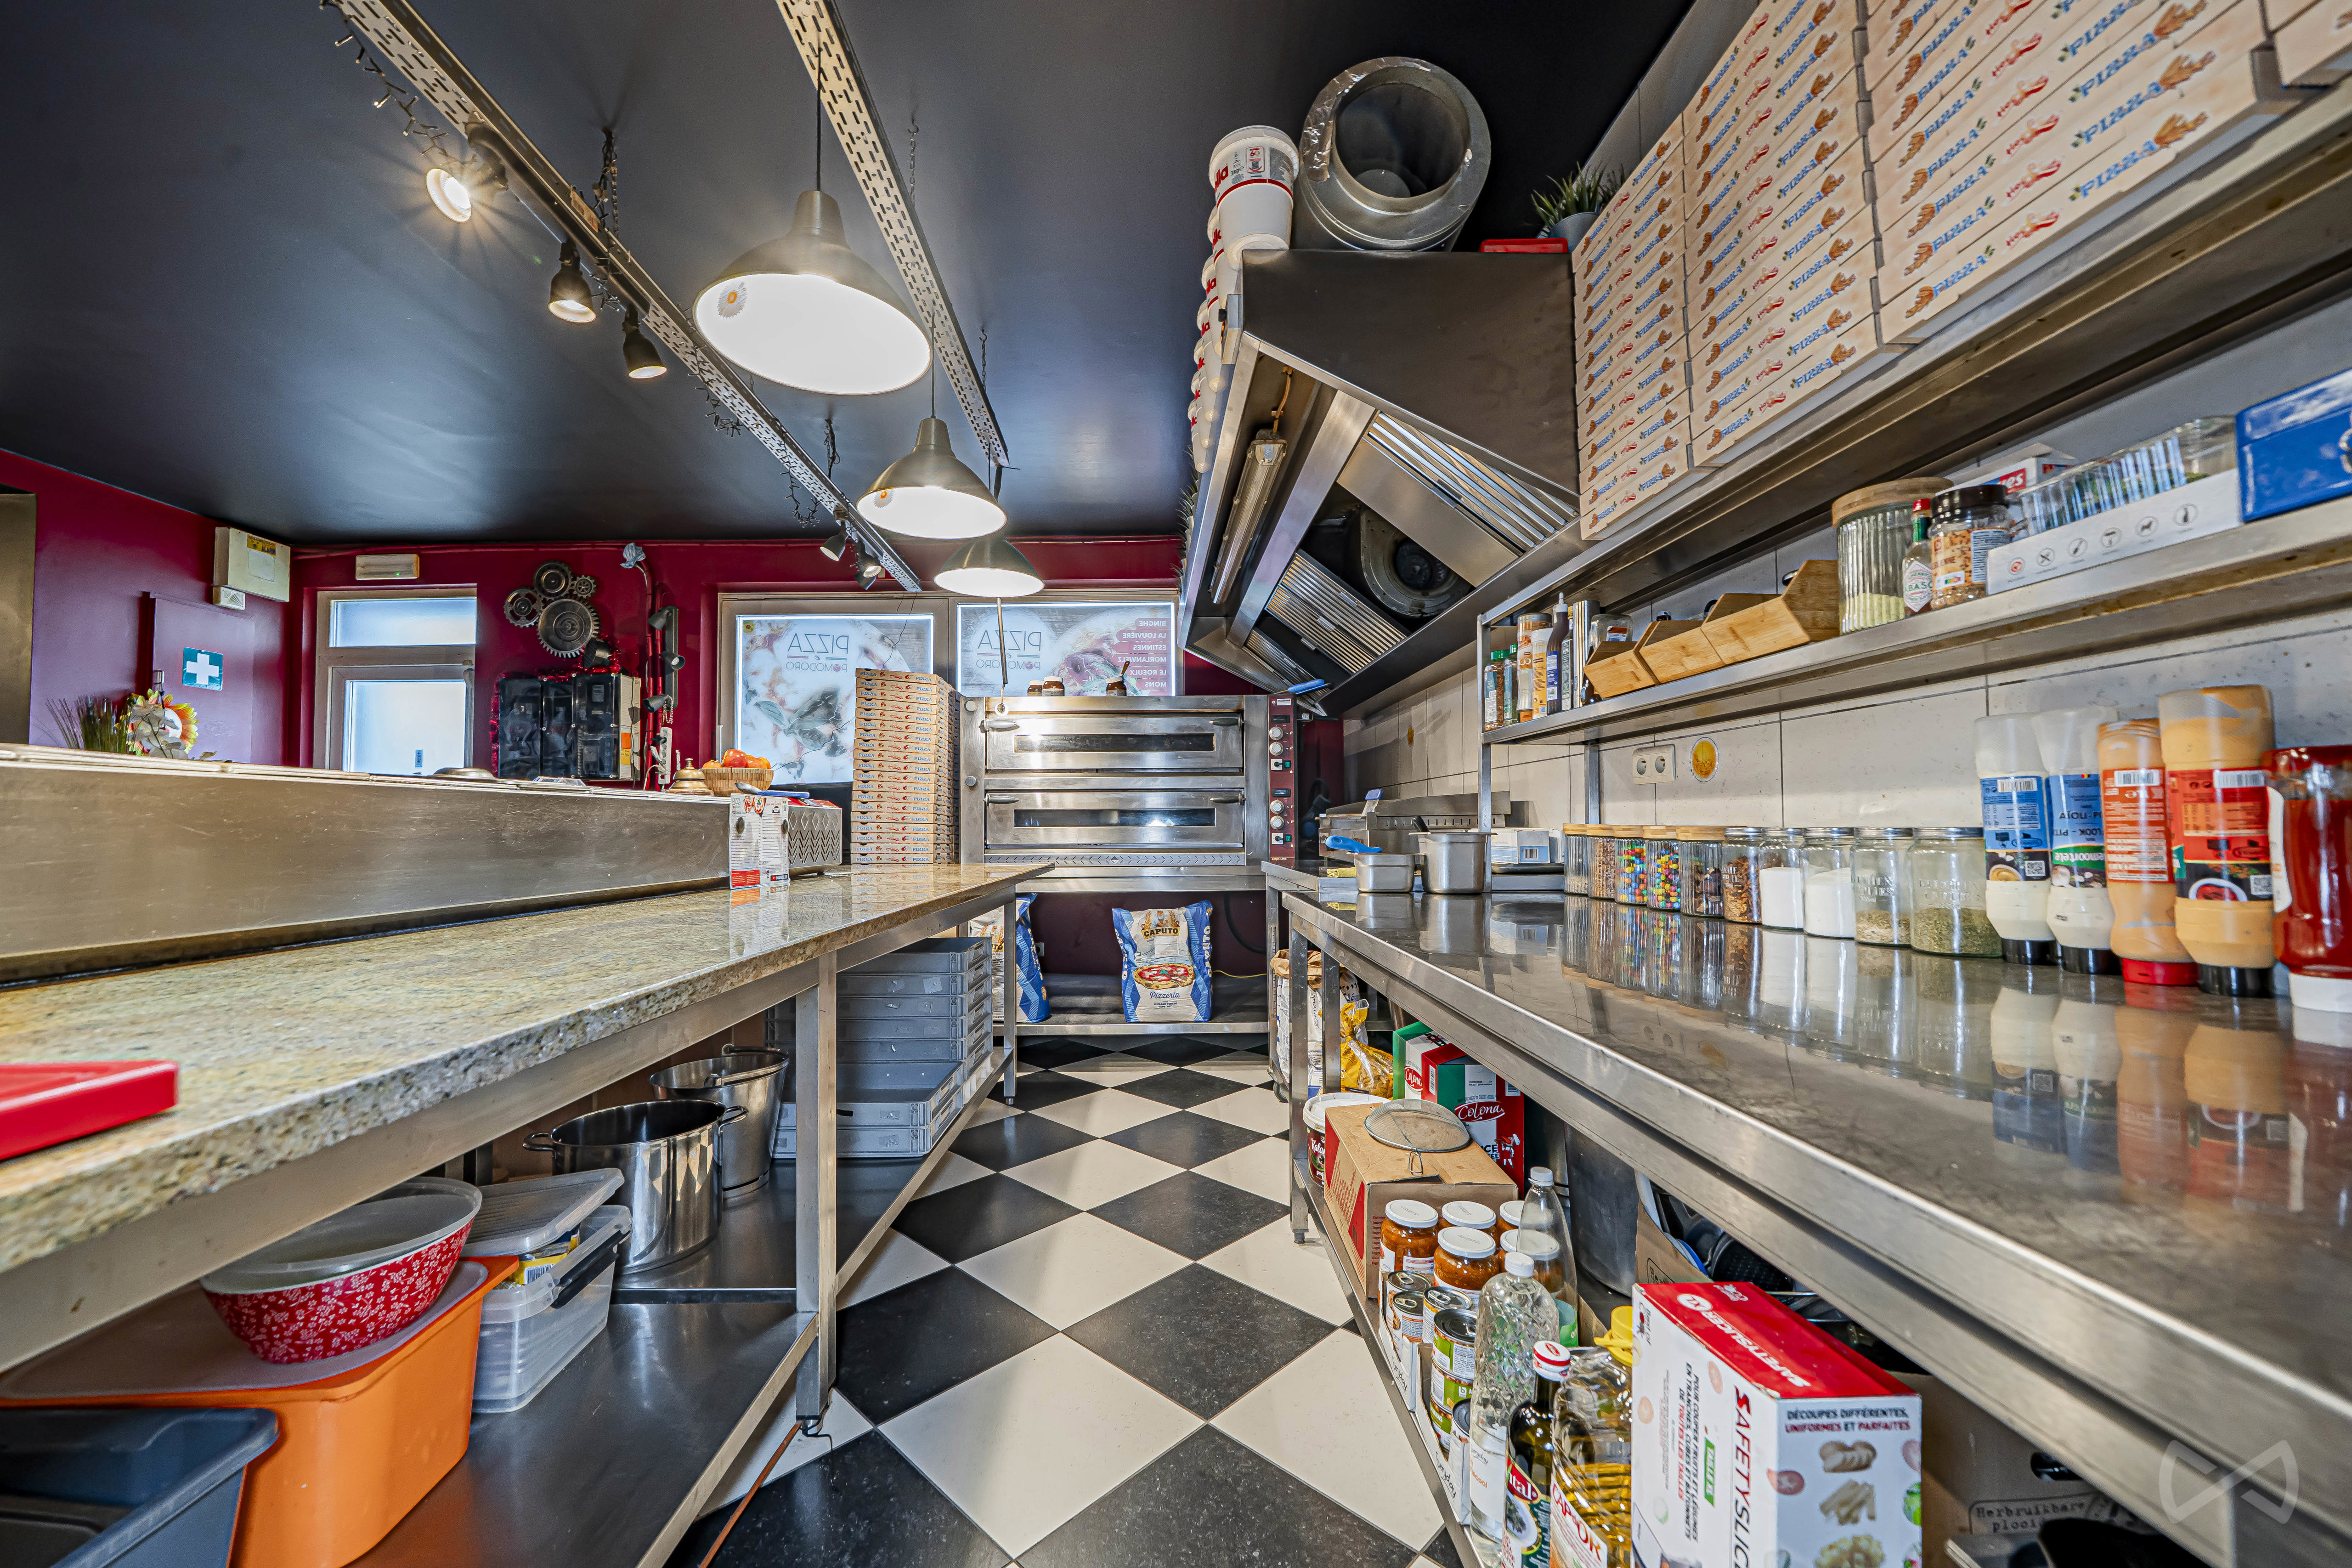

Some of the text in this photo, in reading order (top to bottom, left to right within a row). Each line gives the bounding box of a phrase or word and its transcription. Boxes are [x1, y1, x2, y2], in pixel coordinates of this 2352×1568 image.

[1922, 7, 1971, 62] PIZZA
[1918, 50, 1968, 102] PIZZA
[2080, 33, 2158, 97] PIZZA
[1925, 90, 1974, 141] PIZZA
[2084, 82, 2163, 144] PIZZA
[1928, 129, 1979, 177] PIZZA
[2080, 141, 2158, 198] PIZZA
[1935, 166, 1987, 214] PIZZA
[1932, 207, 1987, 254] PIZZA
[1933, 255, 1987, 297] PIZZA
[1143, 927, 1179, 937] CAPUTO
[1149, 991, 1181, 999] Pizzeria
[1405, 1068, 1422, 1087] Colona
[1458, 1104, 1503, 1120] Colona
[1701, 1311, 1810, 1387] SAFETYSLICER
[1679, 1387, 1685, 1402] DE
[1786, 1408, 1838, 1420] DÉCOUPES
[1786, 1421, 1911, 1433] UNIFORMES ET PARFAITES
[1692, 1480, 1700, 1493] ET
[1734, 1385, 1752, 1568] SAFETYSLIC
[1976, 1502, 2085, 1517] Herbruikbare
